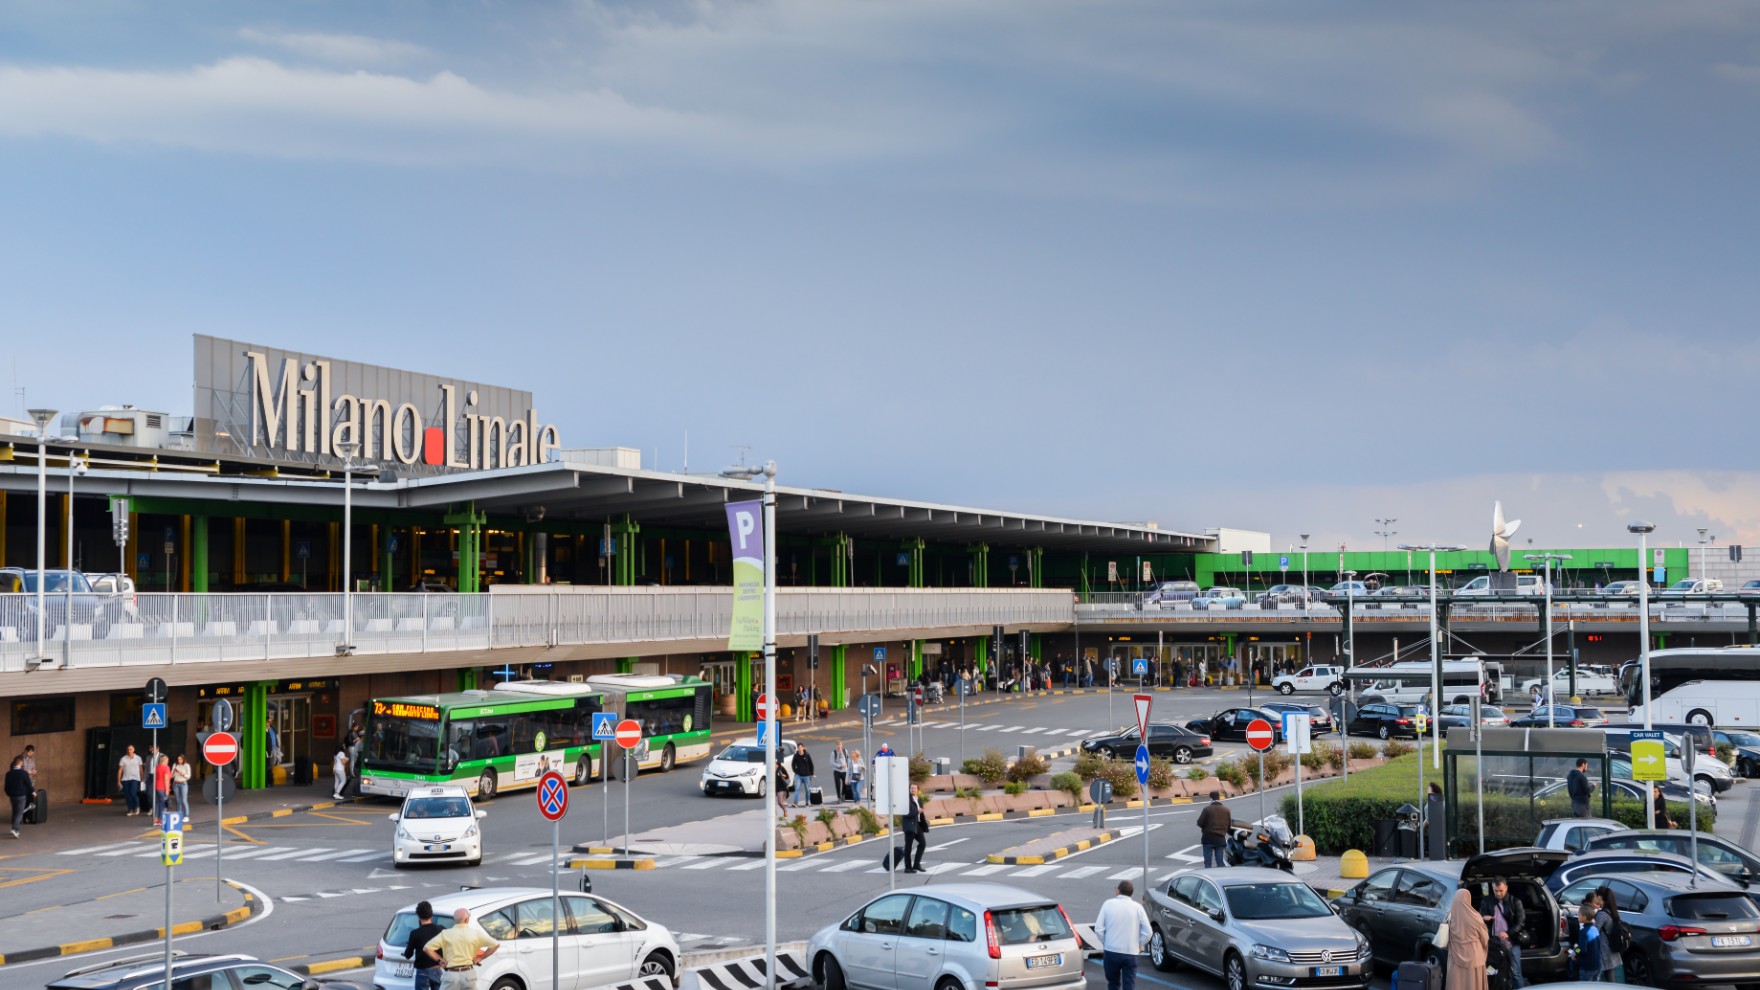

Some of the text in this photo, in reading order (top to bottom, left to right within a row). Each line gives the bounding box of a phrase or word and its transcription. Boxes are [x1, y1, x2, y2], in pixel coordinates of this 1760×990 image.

[244, 351, 561, 470] Milano Linate
[736, 511, 755, 549] P
[1281, 556, 1287, 565] P
[1418, 705, 1424, 714] P
[170, 813, 180, 830] P
